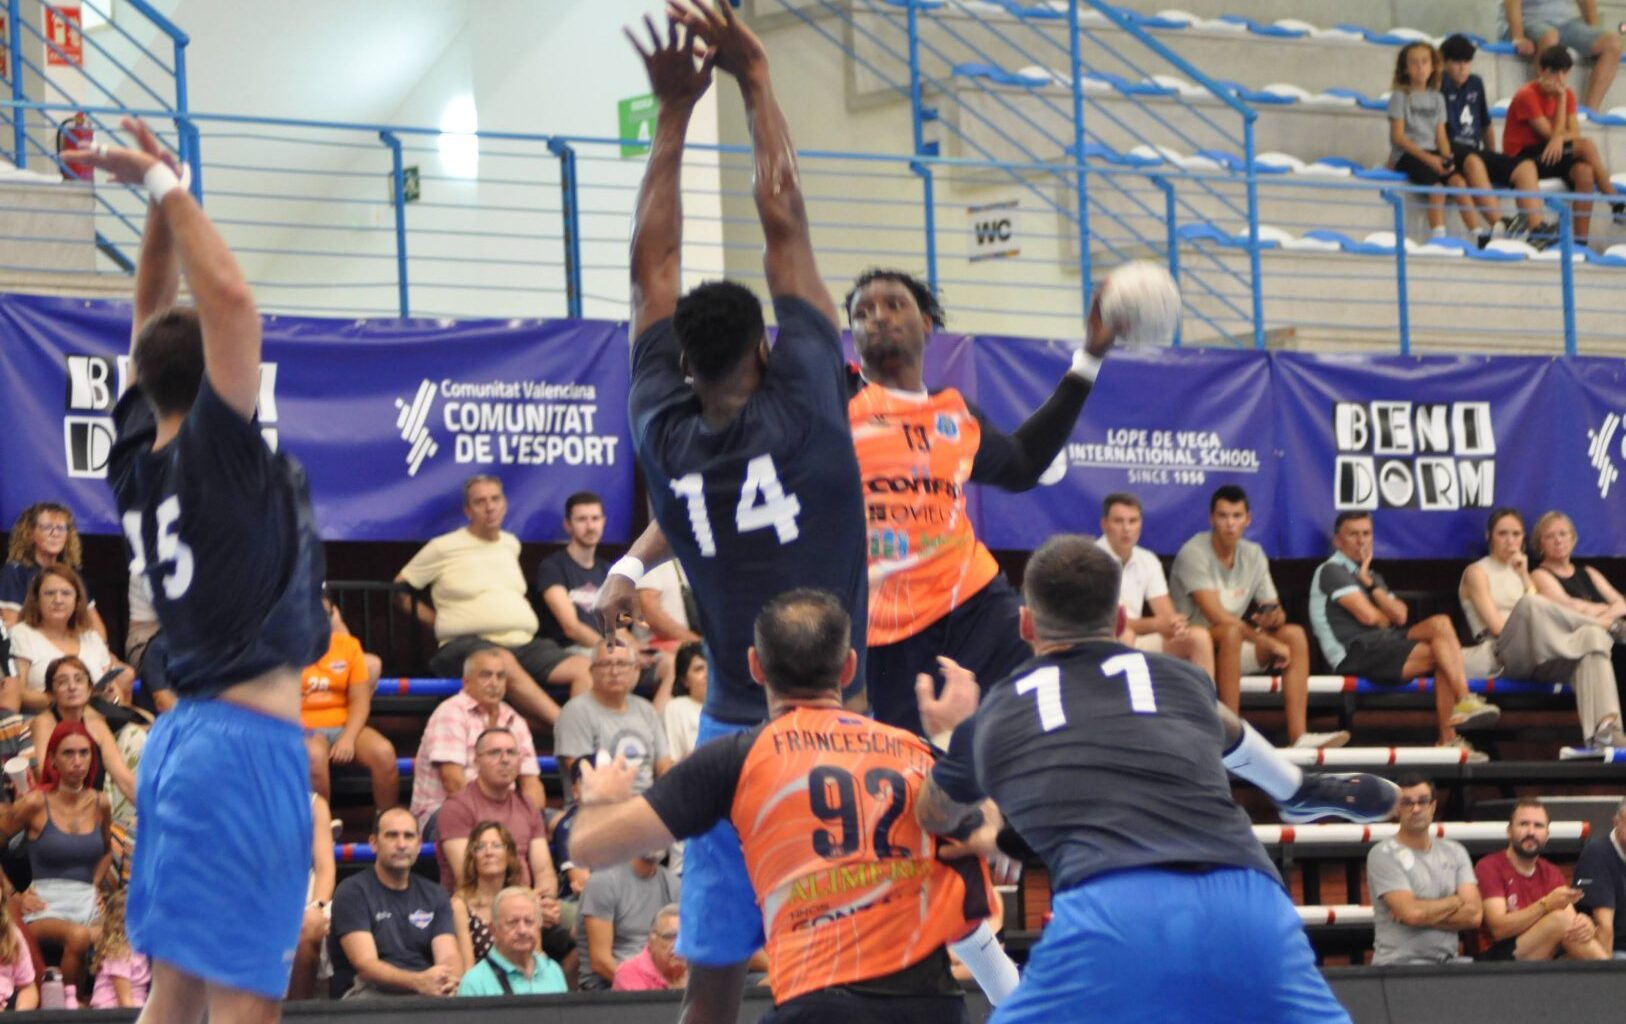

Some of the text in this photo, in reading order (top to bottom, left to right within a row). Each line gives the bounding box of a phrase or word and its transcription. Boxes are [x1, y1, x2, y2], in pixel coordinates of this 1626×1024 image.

[974, 219, 1011, 245] WC
[441, 380, 596, 400] Comunitat Valenciana
[443, 402, 597, 433] COMUNITAT
[1336, 401, 1496, 455] BENI
[455, 434, 618, 466] DE L'ESPORT
[1107, 428, 1222, 449] LOPE DE VEGA
[1069, 443, 1260, 468] INTERNATIONAL SCHOOL
[1127, 469, 1170, 485] SINCE
[1335, 456, 1496, 511] DORM
[669, 452, 801, 557] 14
[122, 494, 194, 600] 15
[1015, 652, 1157, 732] 11
[809, 765, 912, 861] 92
